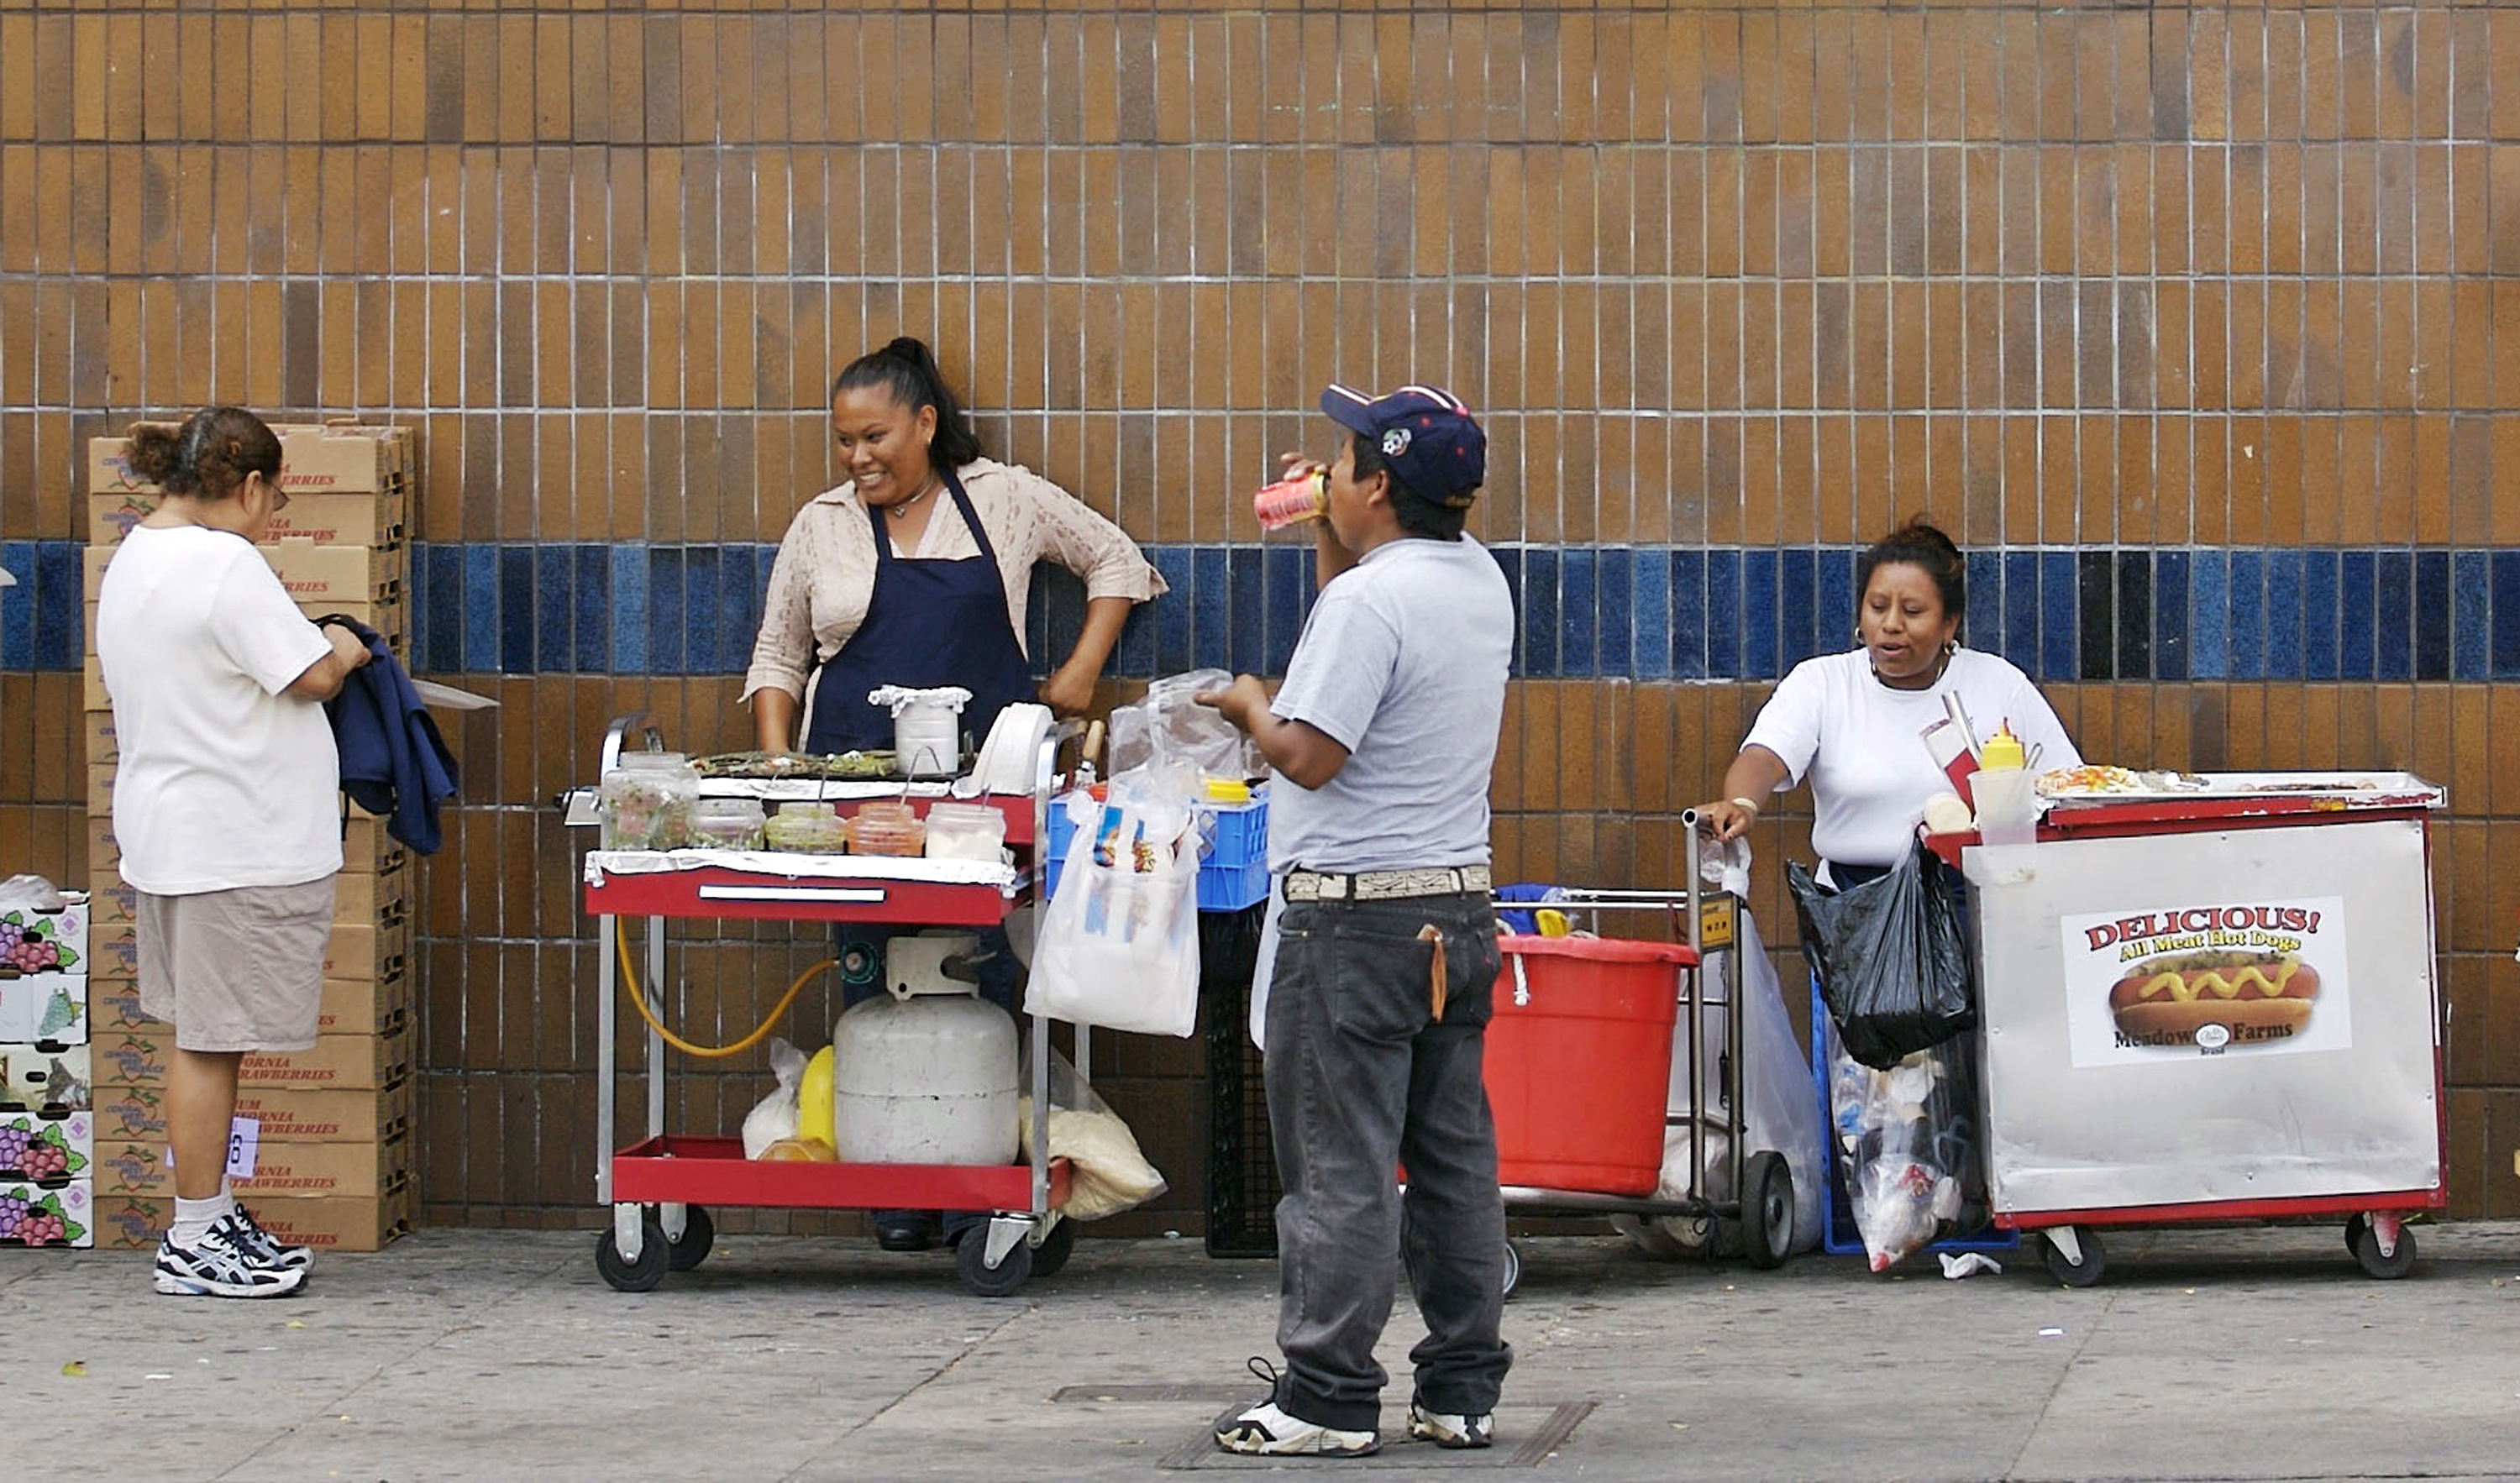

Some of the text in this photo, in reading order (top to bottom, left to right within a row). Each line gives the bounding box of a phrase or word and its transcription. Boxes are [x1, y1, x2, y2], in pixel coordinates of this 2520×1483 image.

[2085, 906, 2321, 951] DELICIOUS!
[2119, 929, 2301, 962] All Meat Hot Dogs
[2114, 1030, 2195, 1048] Meadow
[2233, 1021, 2293, 1040] Farms
[240, 1057, 291, 1067] ORNIA
[239, 1070, 336, 1080] RAWBERRIES
[260, 1124, 340, 1134] WBERRIES
[228, 1177, 337, 1188] TRAWBERRIES
